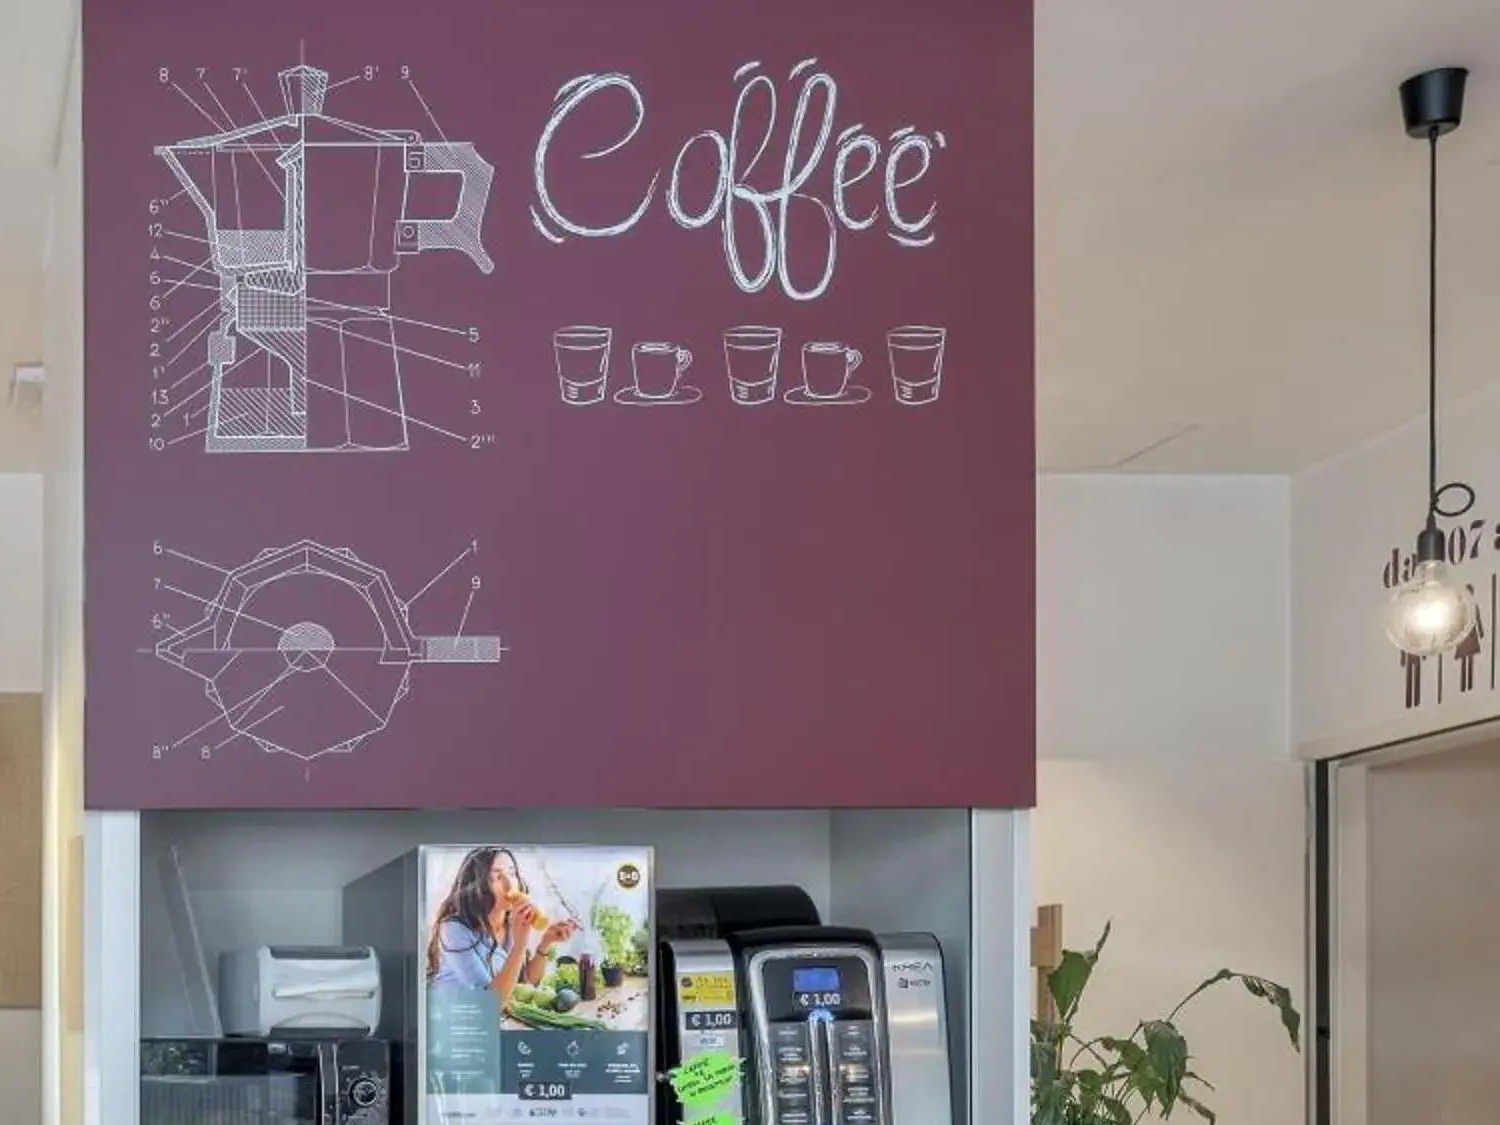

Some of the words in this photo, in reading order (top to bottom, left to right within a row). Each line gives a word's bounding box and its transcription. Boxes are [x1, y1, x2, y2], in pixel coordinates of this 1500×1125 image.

[530, 60, 944, 300] Coffee
[706, 1013, 731, 1027] 1,00
[524, 1083, 536, 1097] €
[539, 1083, 565, 1099] 1,00
